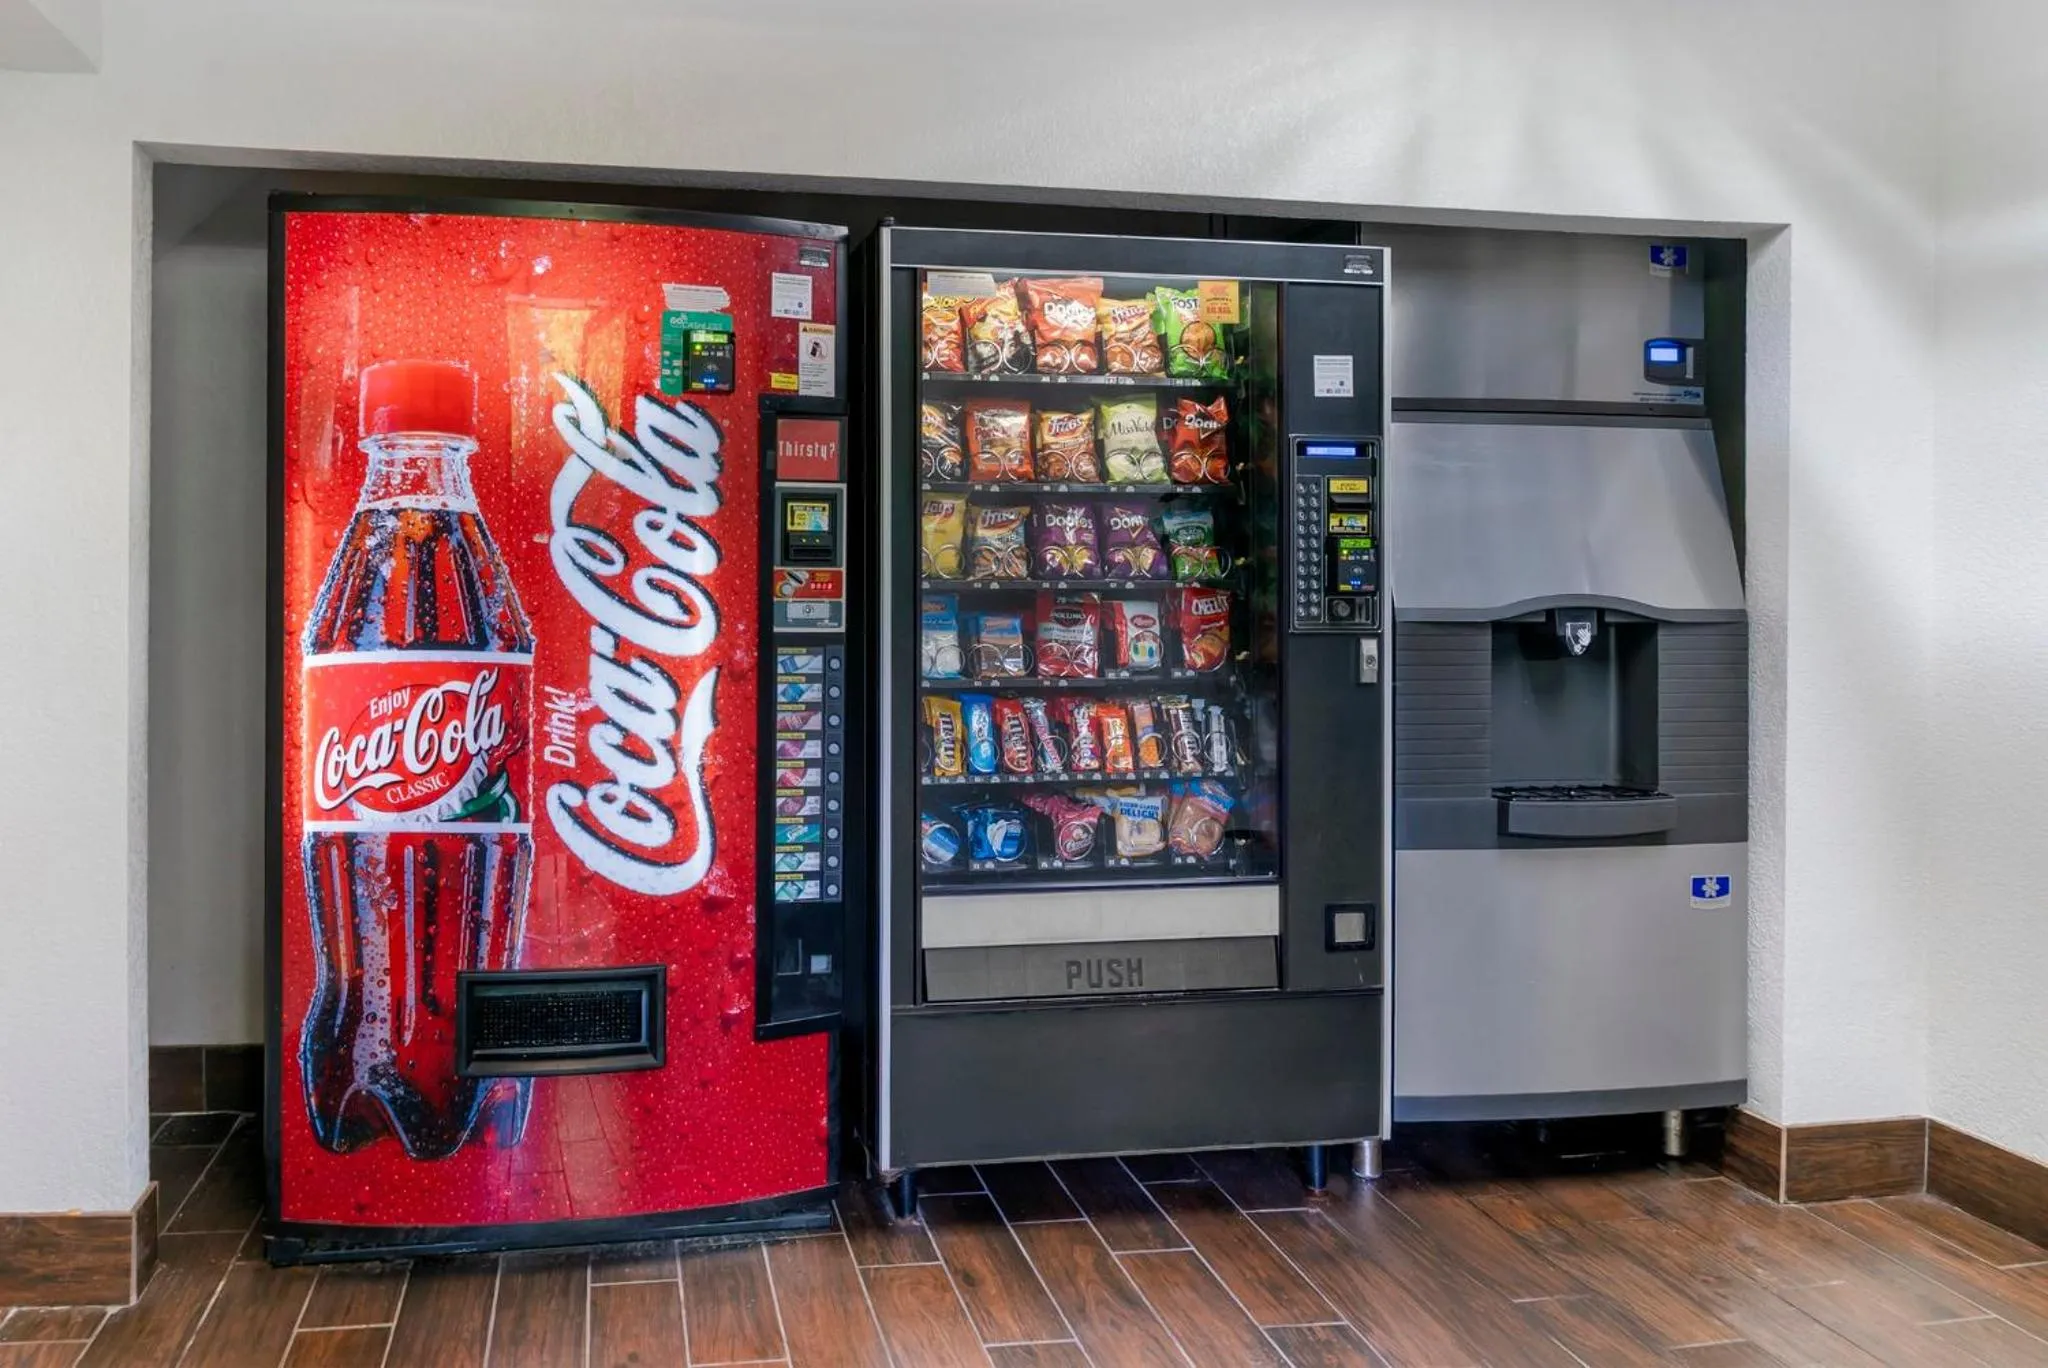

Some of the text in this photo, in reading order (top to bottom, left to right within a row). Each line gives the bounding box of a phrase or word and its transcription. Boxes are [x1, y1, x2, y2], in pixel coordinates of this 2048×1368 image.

[1171, 297, 1200, 309] TOST
[779, 440, 836, 461] Thirsty?
[547, 371, 725, 896] Coca-Cola
[369, 687, 412, 720] Enjoy
[313, 666, 506, 811] Coca-Cola
[544, 685, 577, 770] Drink!
[386, 772, 450, 805] CLASSIC
[1066, 957, 1144, 990] PUSH
